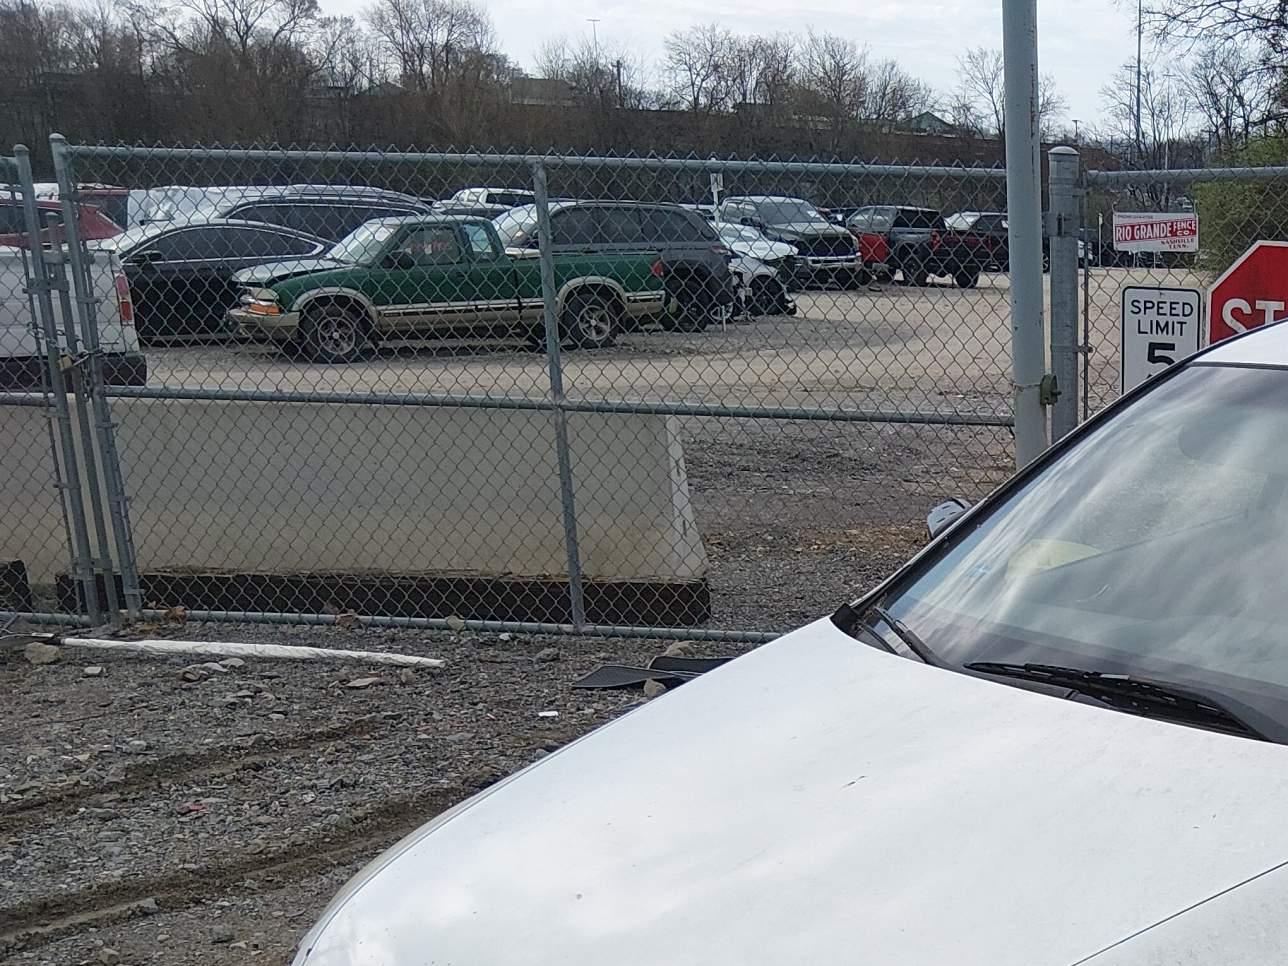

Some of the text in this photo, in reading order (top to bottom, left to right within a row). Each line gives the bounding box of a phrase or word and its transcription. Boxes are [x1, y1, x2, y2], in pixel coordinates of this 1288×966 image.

[1115, 220, 1196, 241] RIO GRANDE FENCE
[1130, 299, 1194, 318] SPEED
[1137, 319, 1187, 337] LIMIT
